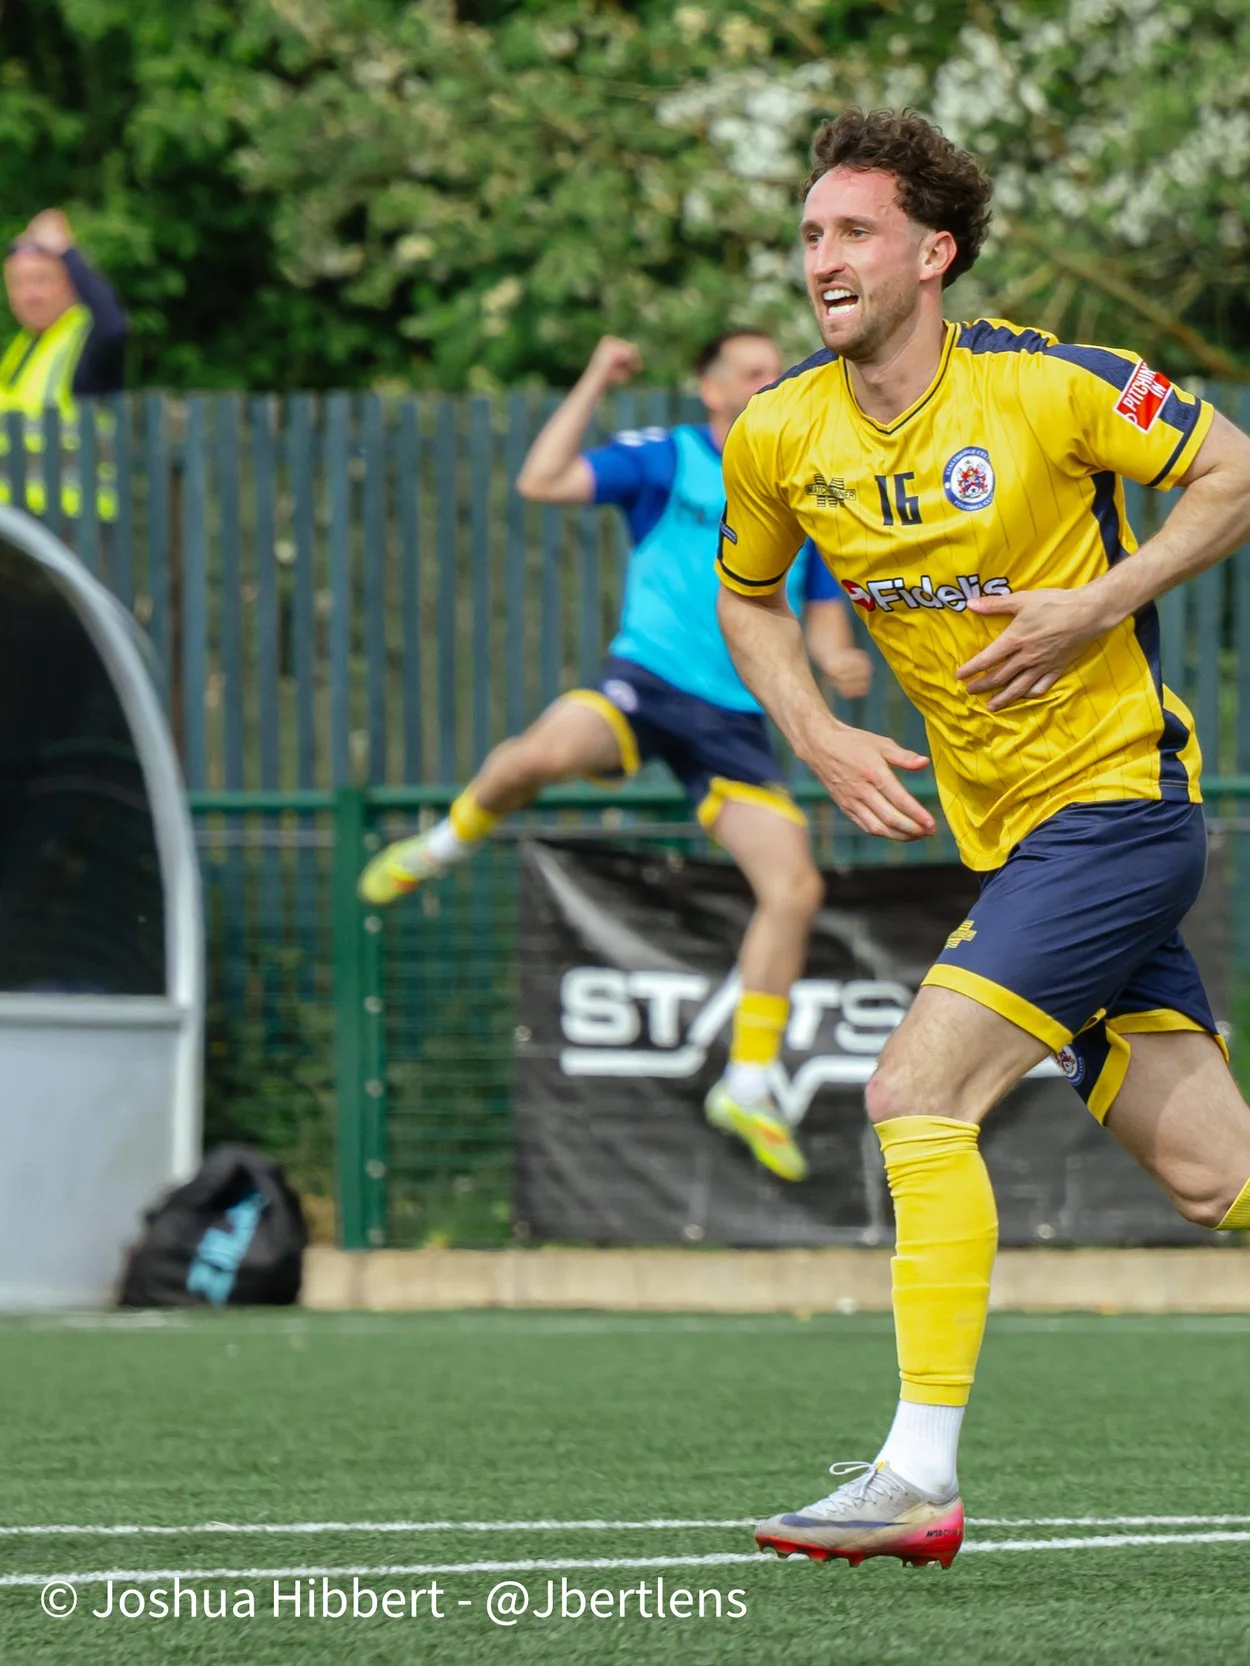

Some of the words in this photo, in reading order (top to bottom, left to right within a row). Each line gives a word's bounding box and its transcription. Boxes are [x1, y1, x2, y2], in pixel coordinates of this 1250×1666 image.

[1122, 361, 1157, 413] PITCHIN
[874, 471, 923, 526] 16
[866, 573, 1014, 613] Fidelis
